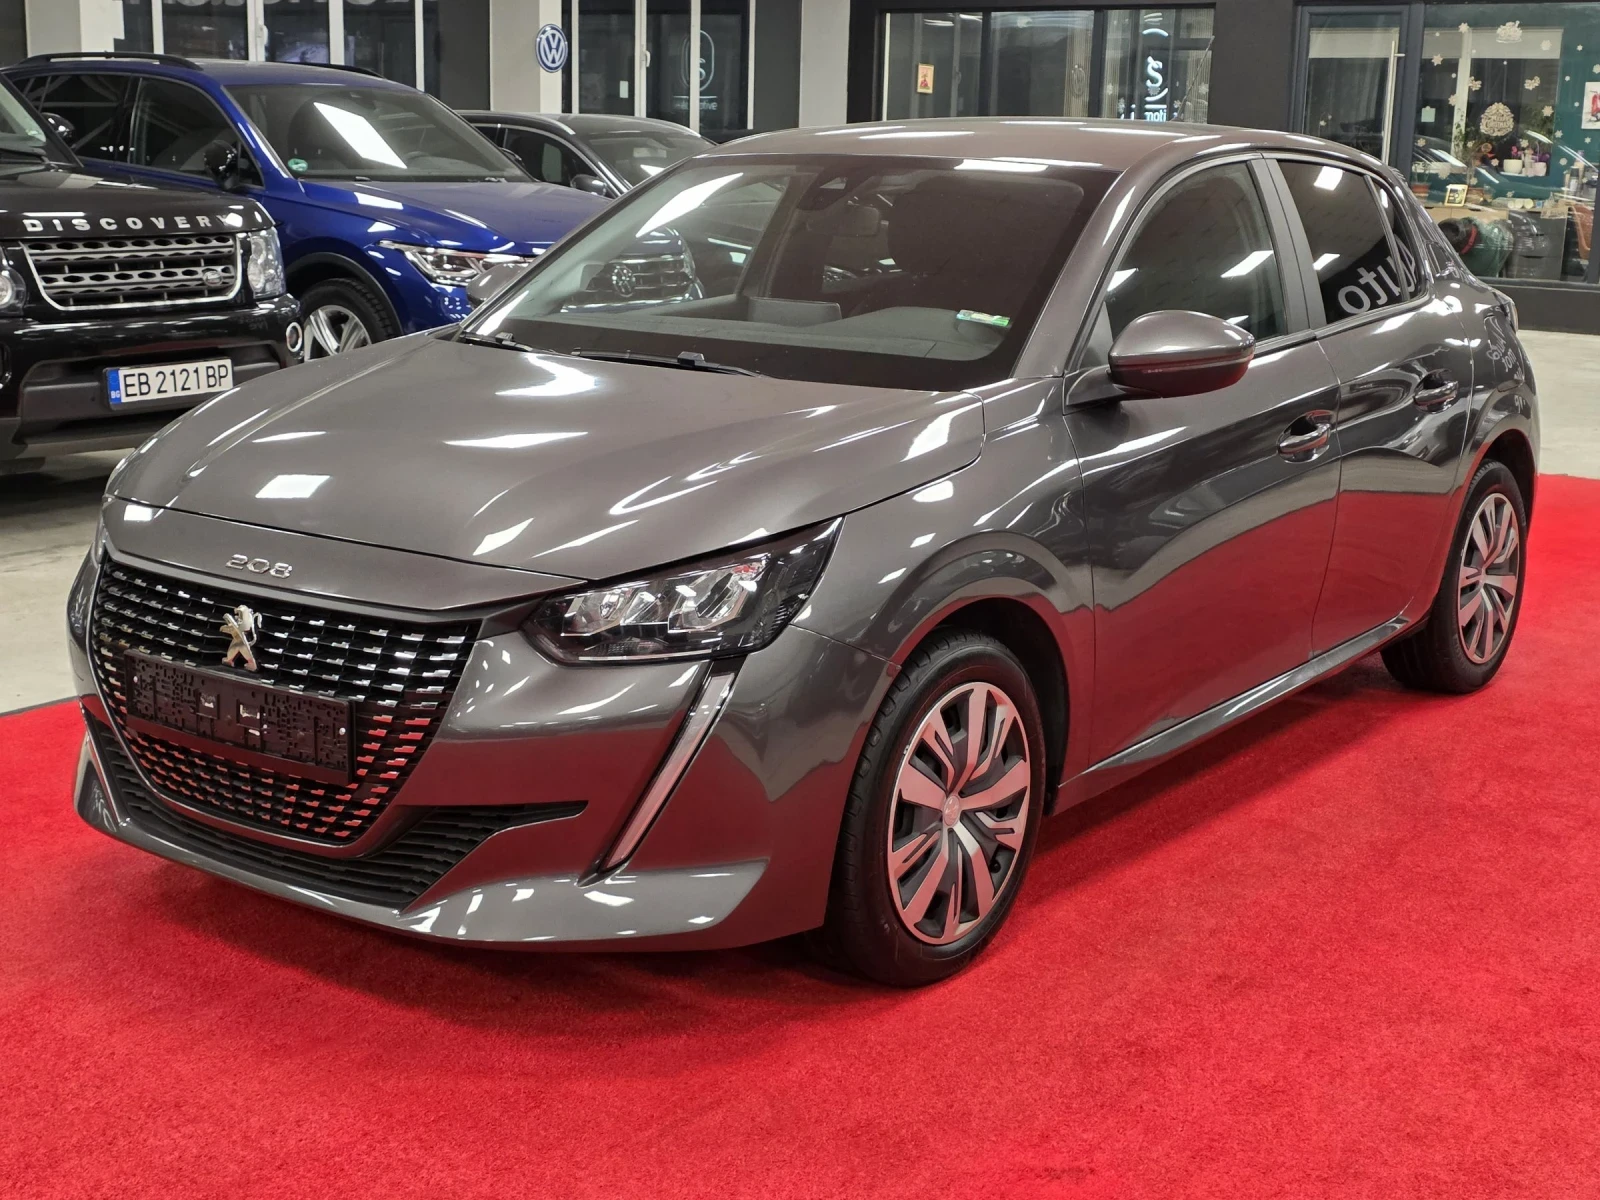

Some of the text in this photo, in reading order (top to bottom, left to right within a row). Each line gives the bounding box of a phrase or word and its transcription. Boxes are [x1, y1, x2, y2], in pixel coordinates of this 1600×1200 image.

[539, 27, 566, 70] VW
[110, 390, 120, 399] BG
[122, 363, 229, 398] EB 2121 BP
[225, 553, 293, 579] 208
